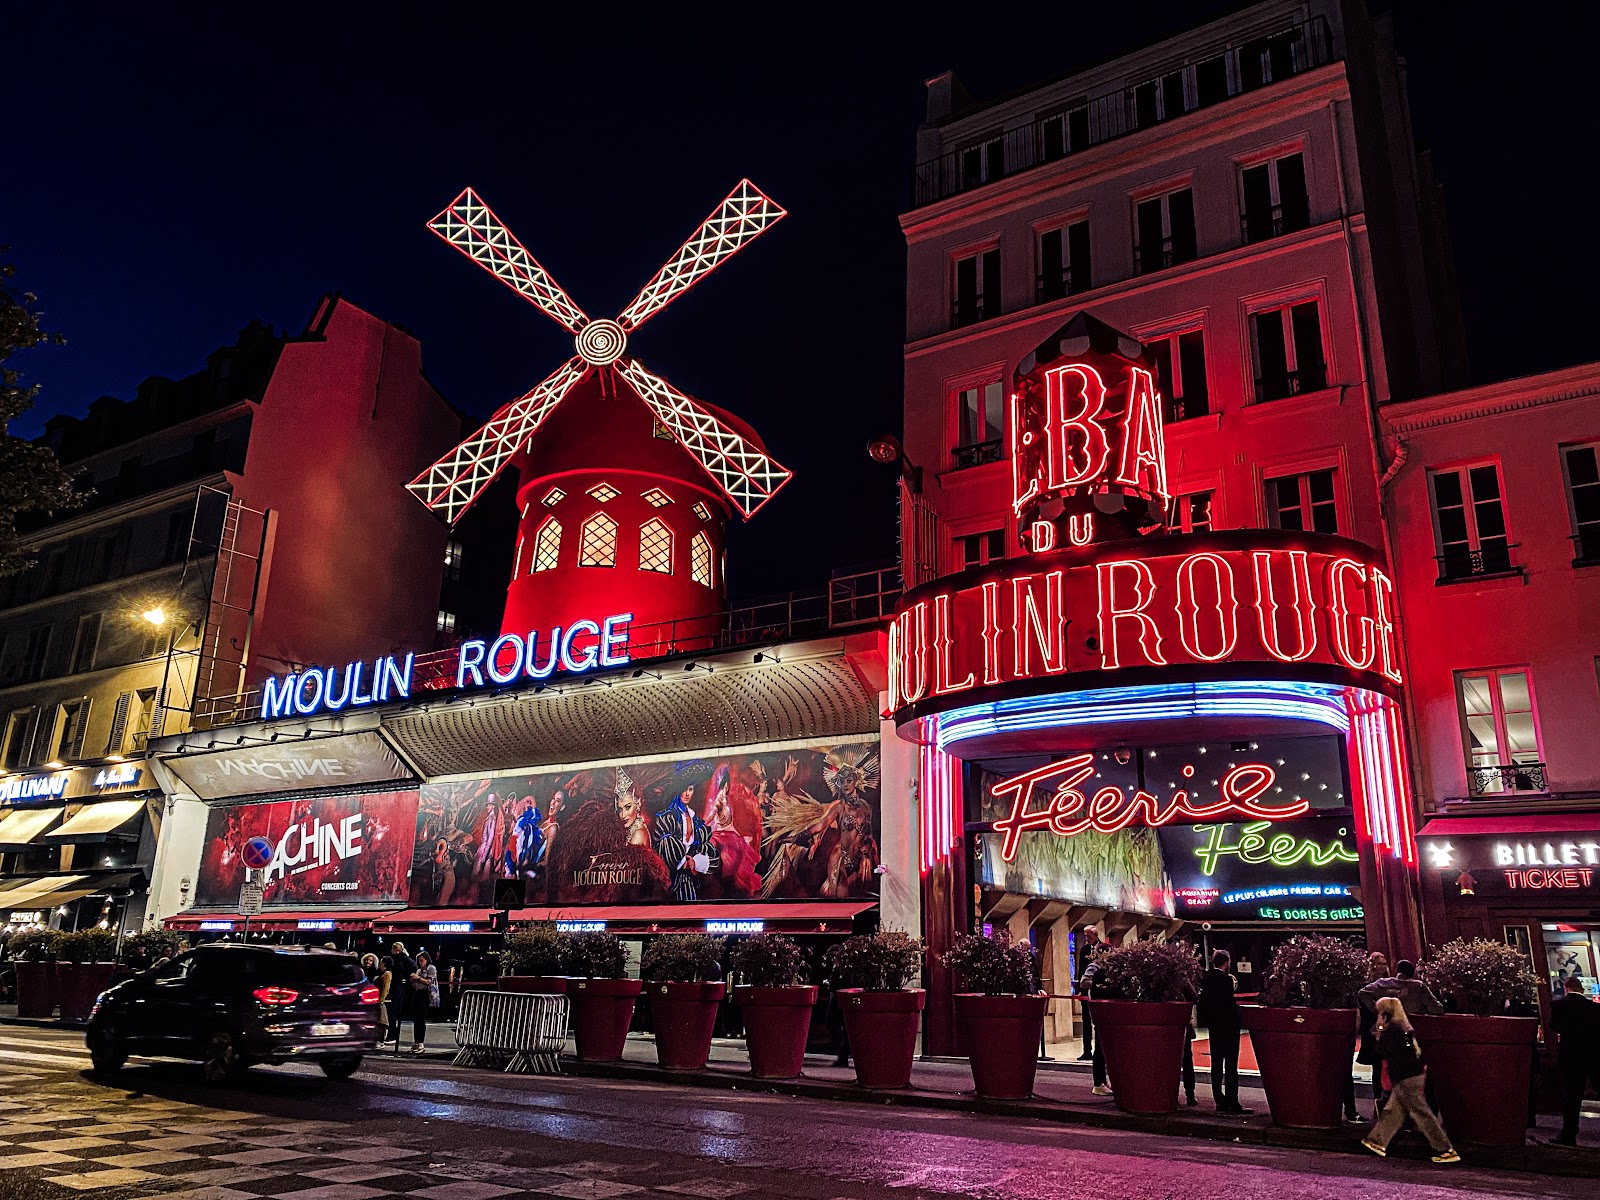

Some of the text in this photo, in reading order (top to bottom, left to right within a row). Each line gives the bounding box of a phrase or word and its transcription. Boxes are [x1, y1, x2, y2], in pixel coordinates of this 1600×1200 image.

[1032, 513, 1093, 552] DU
[1095, 550, 1402, 684] ROUGE
[260, 612, 634, 720] MOULIN ROUGE
[991, 753, 1309, 862] Féerie
[245, 812, 362, 884] ACHINE
[1495, 843, 1600, 866] BILLET
[584, 852, 630, 872] Forever
[321, 882, 359, 891] CONCERTS CLUB
[573, 867, 642, 888] MOULIN ROUGE
[1504, 868, 1594, 889] TICKET
[1235, 892, 1255, 902] PLUS
[1260, 907, 1281, 919] LES
[1284, 909, 1328, 920] DORISS
[706, 922, 764, 932] MOULIN ROUGE
